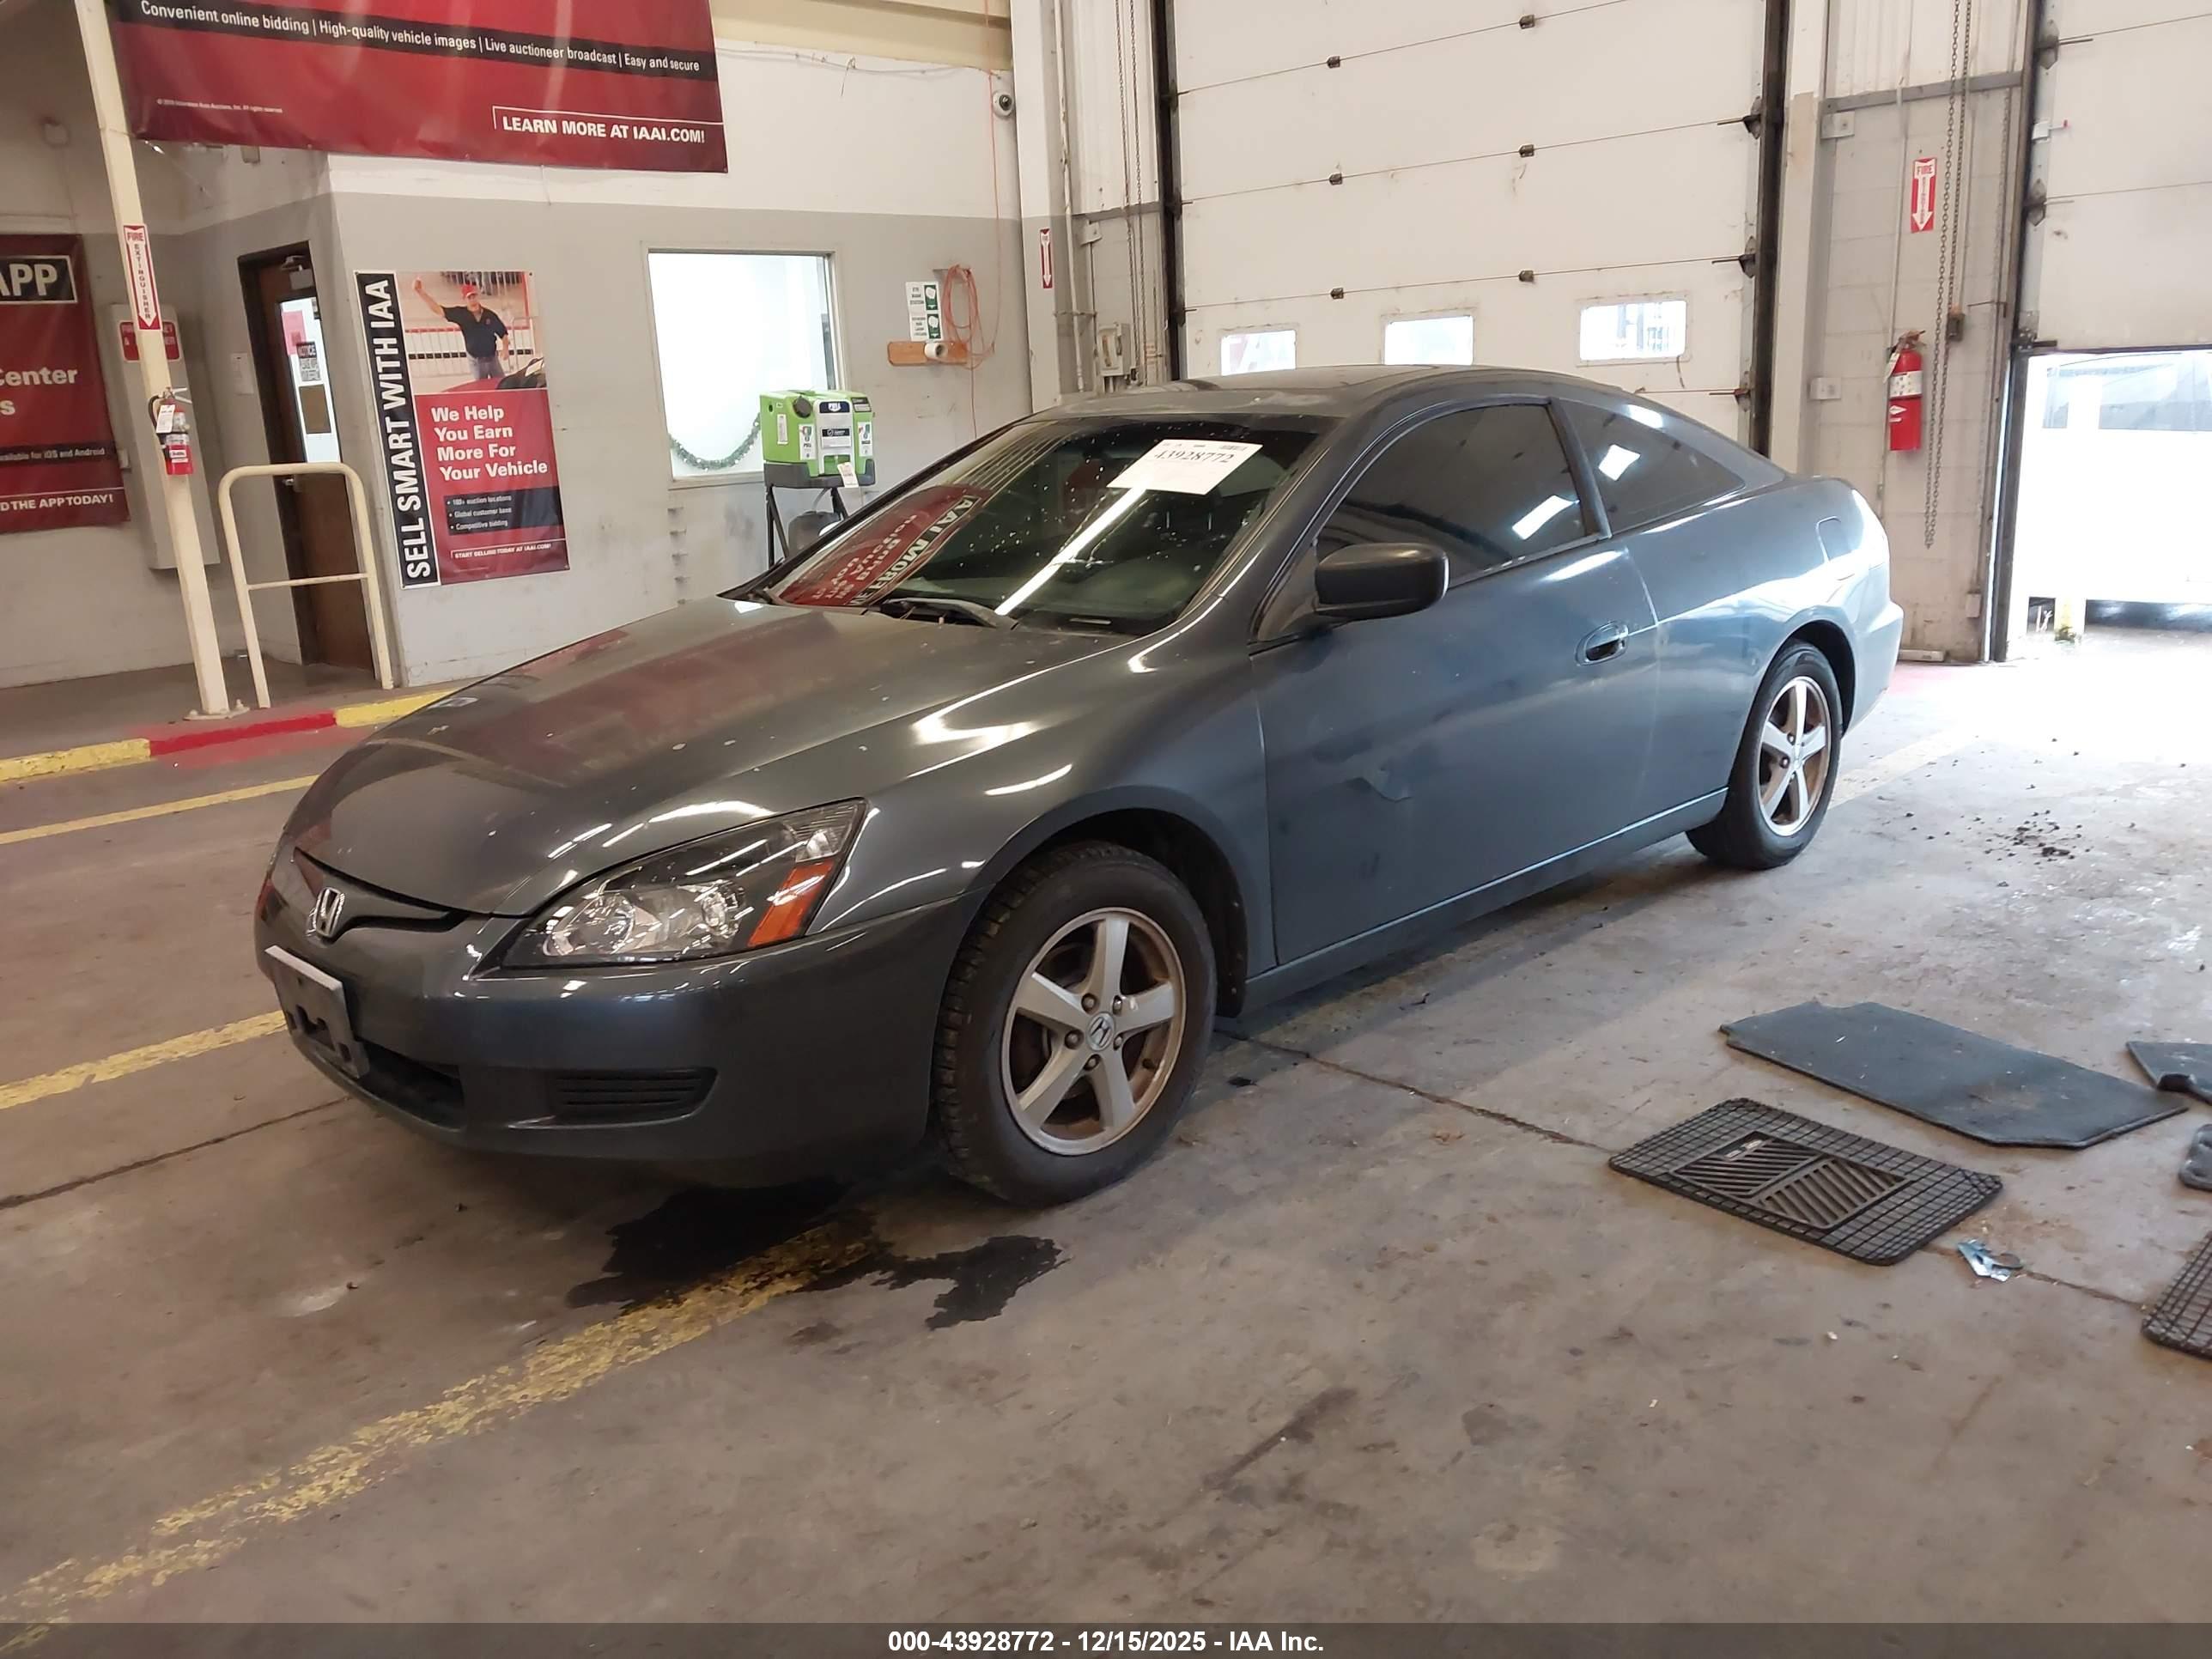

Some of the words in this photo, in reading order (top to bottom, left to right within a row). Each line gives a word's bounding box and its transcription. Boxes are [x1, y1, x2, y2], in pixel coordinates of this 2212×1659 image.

[141, 0, 220, 23] Convenient
[222, 11, 259, 27] online
[263, 15, 309, 34] bidding
[319, 20, 389, 42] High-quality
[392, 30, 432, 46] vehicle
[434, 33, 477, 51] images
[485, 38, 506, 53] Live
[508, 42, 564, 58] auctioneer
[567, 46, 617, 64] broadcast
[624, 53, 647, 70] Easy
[649, 58, 668, 70] and
[670, 59, 700, 71] secure
[502, 116, 557, 134] LEARN
[562, 120, 606, 137] MORE
[611, 124, 629, 139] AT
[633, 126, 705, 143] IAAI.COM!
[126, 232, 144, 242] FIRE
[365, 280, 395, 328] IAA
[372, 337, 406, 410] WITH
[431, 406, 459, 422] We
[464, 404, 504, 422] Help
[434, 426, 469, 442] You
[473, 424, 513, 440] Earn
[386, 416, 421, 511] SMART
[437, 446, 483, 462] More
[488, 443, 516, 458] For
[439, 465, 481, 481] Your
[484, 459, 548, 477] Vehicle
[10, 499, 36, 511] THE
[39, 497, 64, 509] APP
[64, 494, 113, 506] TODAY!
[401, 517, 432, 579] SELL
